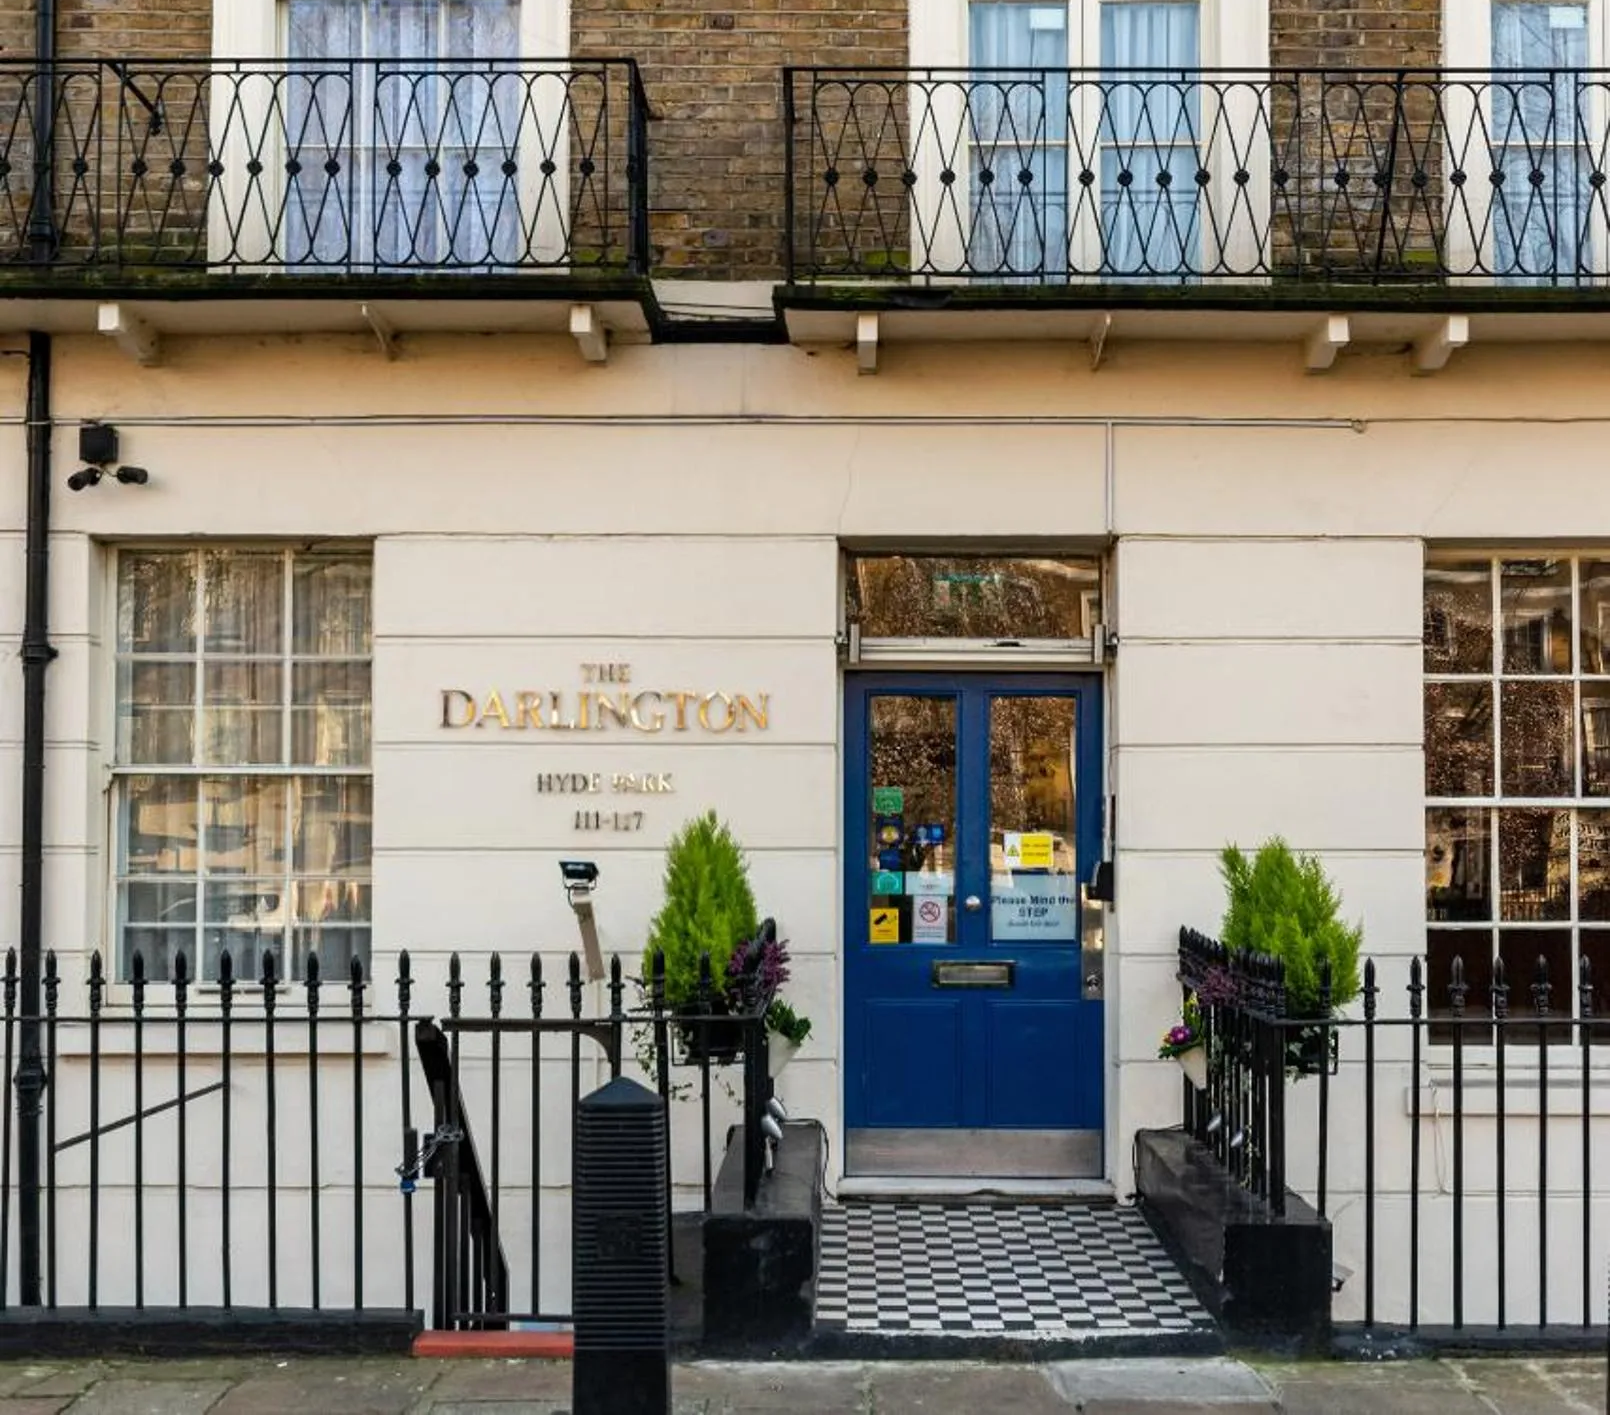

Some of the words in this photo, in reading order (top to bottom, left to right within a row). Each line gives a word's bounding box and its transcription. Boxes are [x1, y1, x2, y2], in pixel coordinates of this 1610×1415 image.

[580, 662, 632, 684] THE
[440, 689, 769, 732] DARLINGTON
[537, 772, 601, 794] HYDE
[612, 772, 676, 794] PARK
[991, 895, 1026, 905] Please
[1030, 894, 1056, 905] Mind
[1018, 907, 1048, 918] STEP
